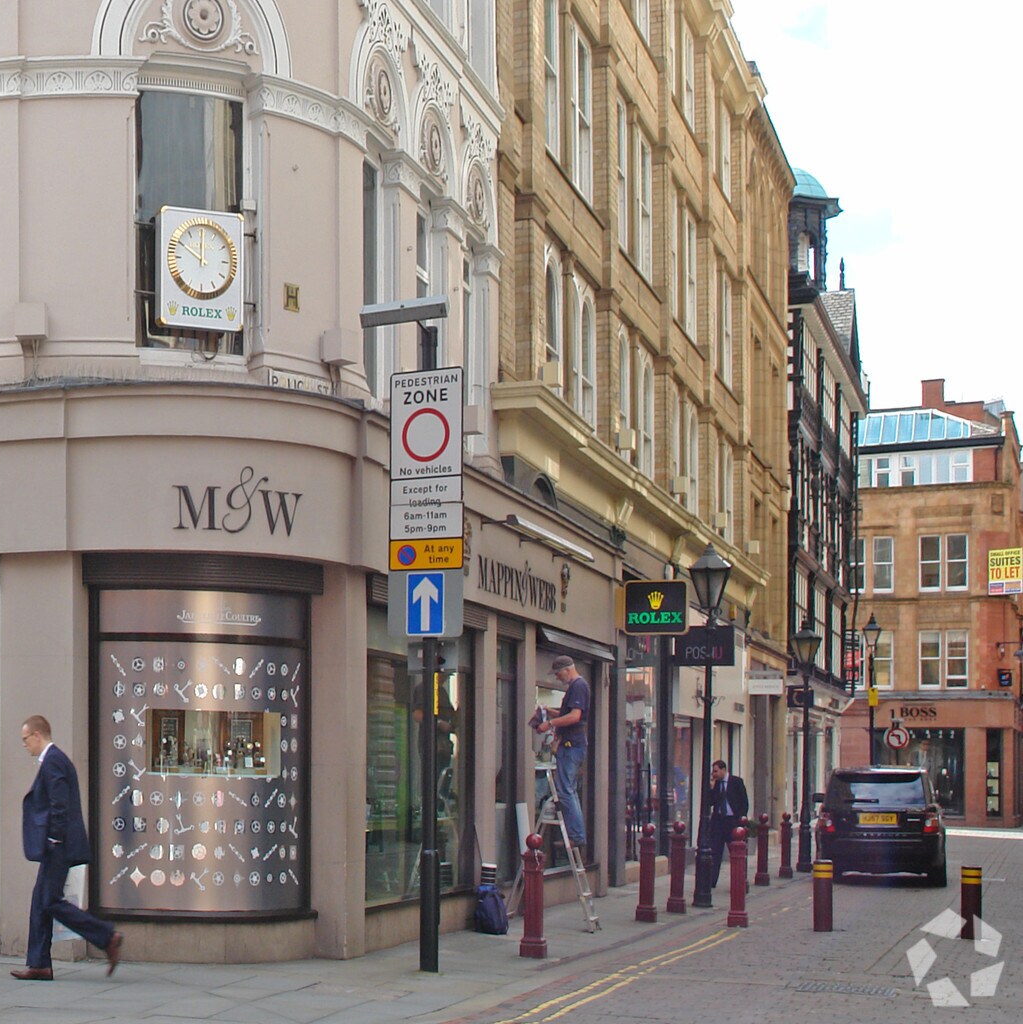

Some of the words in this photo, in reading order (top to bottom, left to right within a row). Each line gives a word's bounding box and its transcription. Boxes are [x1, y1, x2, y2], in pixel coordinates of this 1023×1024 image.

[285, 285, 299, 310] H
[181, 305, 223, 320] ROLEX
[394, 374, 459, 389] PEDESTRIAN
[403, 387, 449, 405] ZONE
[399, 467, 413, 476] No
[415, 464, 453, 475] vehicles
[402, 485, 433, 495] Except
[435, 483, 449, 493] for
[171, 465, 304, 537] M&W
[408, 498, 442, 508] loading
[403, 511, 448, 521] 6am-11am
[404, 523, 447, 534] 5pm-9pm
[423, 544, 435, 553] At
[437, 545, 455, 554] any
[428, 555, 450, 564] time
[989, 556, 1021, 567] SUITES
[989, 567, 1002, 580] TO
[1004, 566, 1020, 579] LET
[627, 610, 683, 625] ROLEX
[899, 706, 937, 718] BOSS
